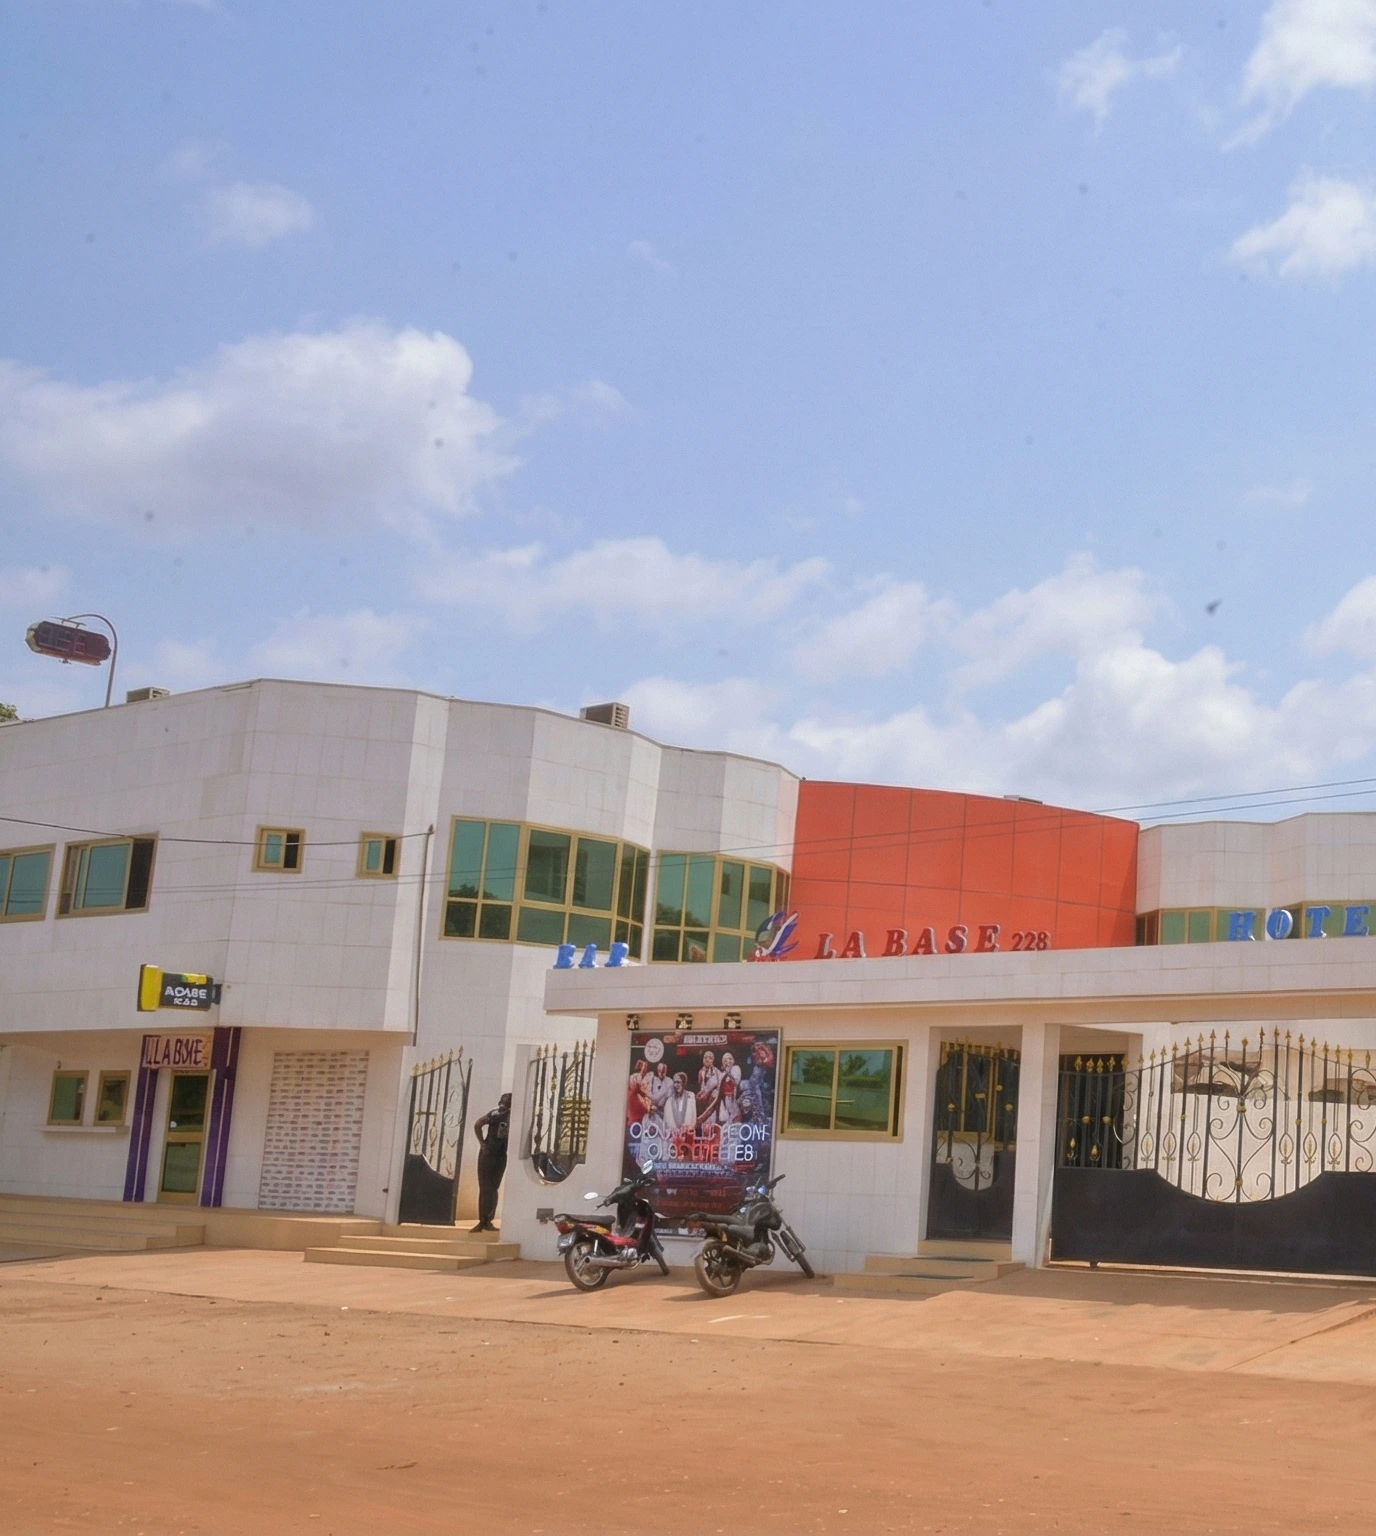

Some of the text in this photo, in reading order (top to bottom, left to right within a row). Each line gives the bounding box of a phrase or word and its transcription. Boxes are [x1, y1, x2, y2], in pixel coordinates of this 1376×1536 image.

[814, 924, 1050, 960] LA BASE 228
